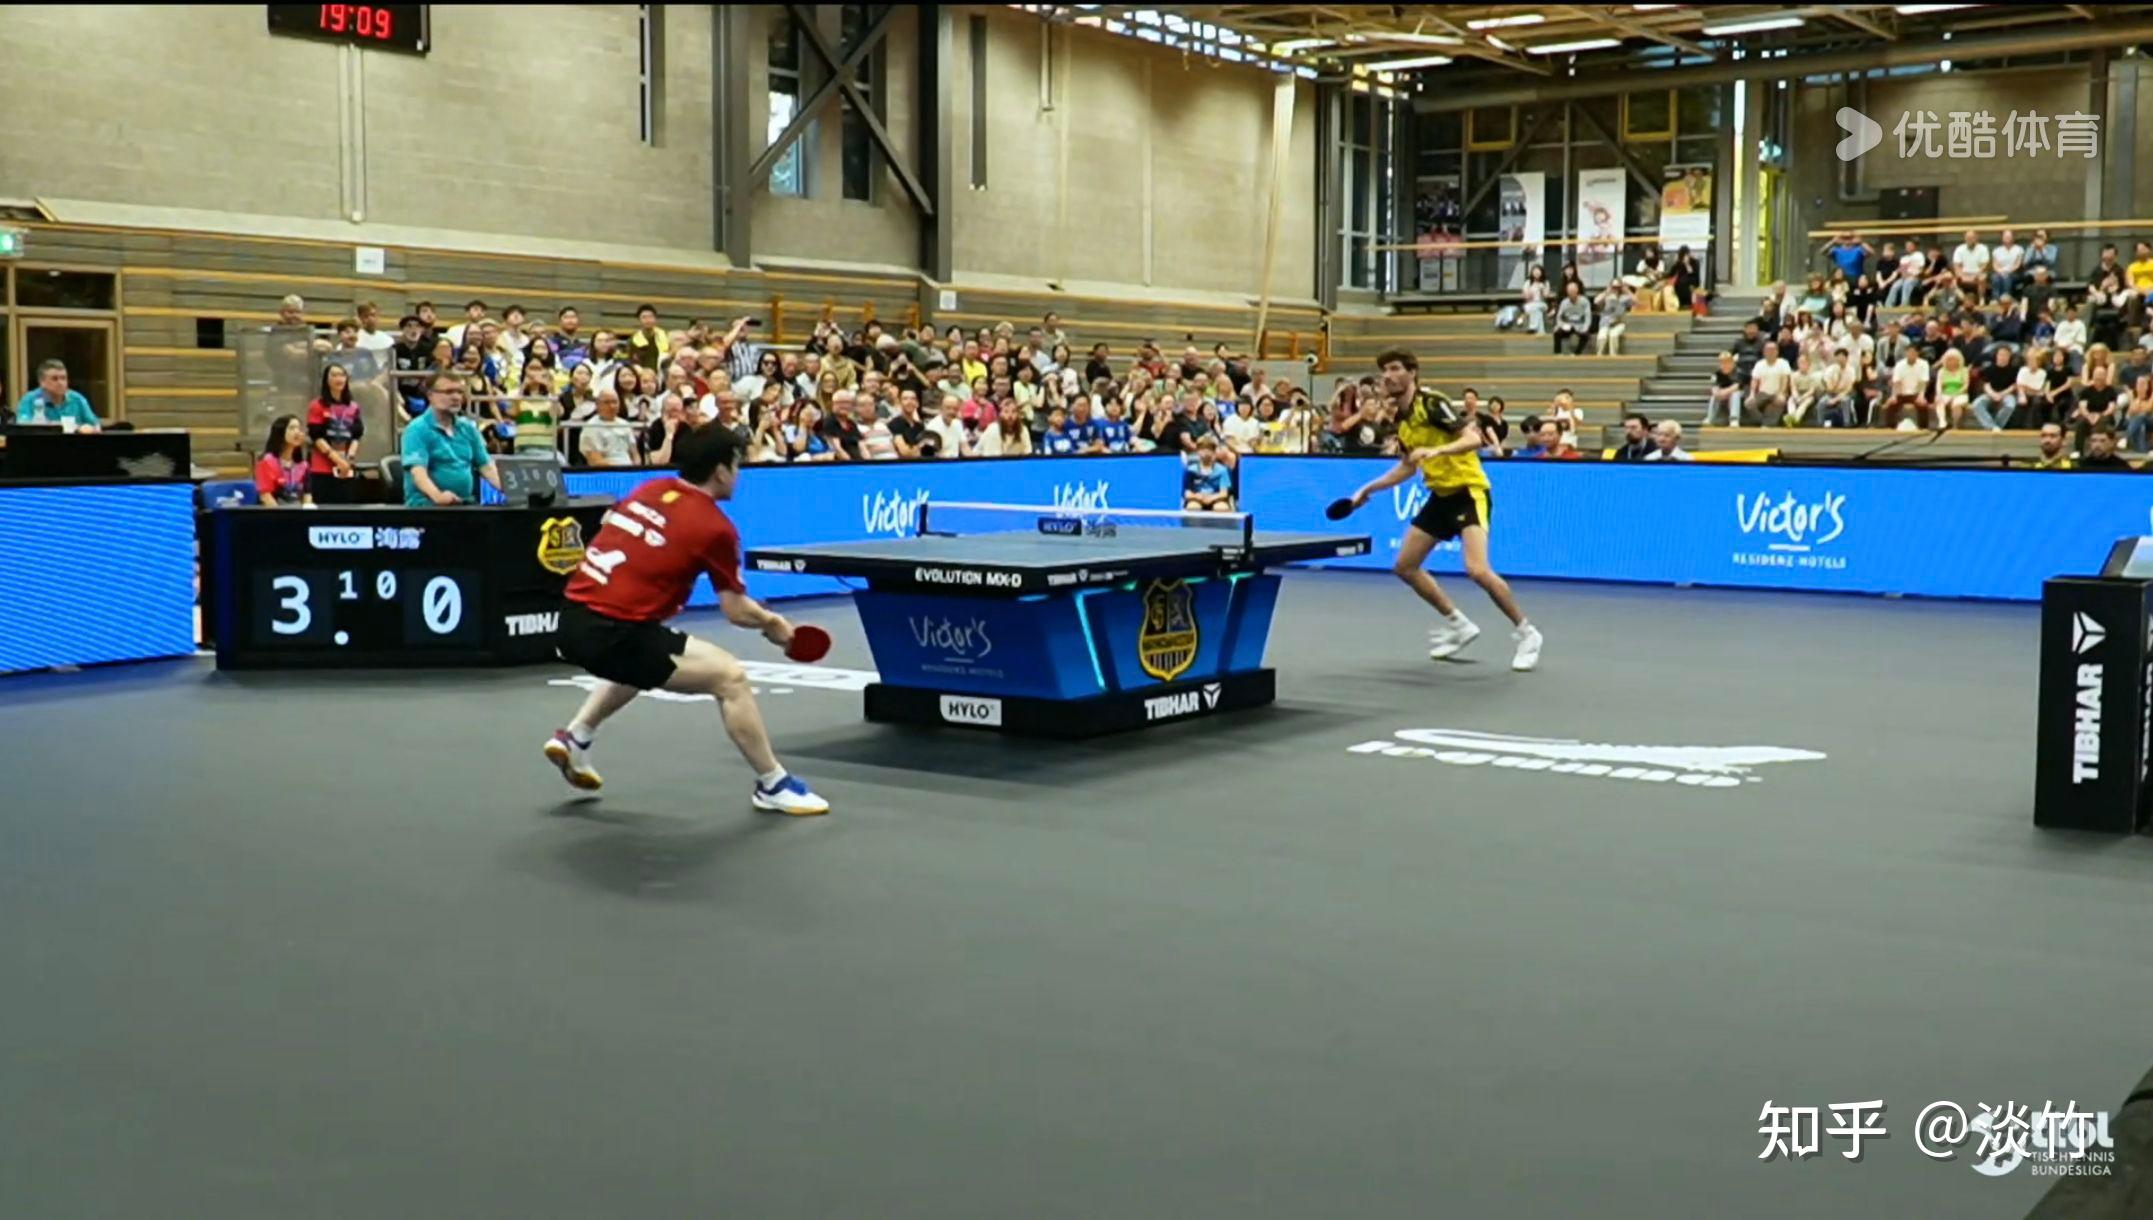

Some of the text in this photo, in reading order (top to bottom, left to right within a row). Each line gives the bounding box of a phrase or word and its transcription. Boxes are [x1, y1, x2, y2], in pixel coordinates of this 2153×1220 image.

[320, 5, 391, 38] 19:09
[1736, 490, 1846, 545] Victor's
[915, 567, 982, 585] EVOLUTION
[272, 570, 461, 634] 3 1 0 0
[908, 615, 992, 658] Victor's
[949, 702, 989, 719] HYLO
[1144, 691, 1200, 720] TIBHAR
[2072, 663, 2104, 784] TIBHAR
